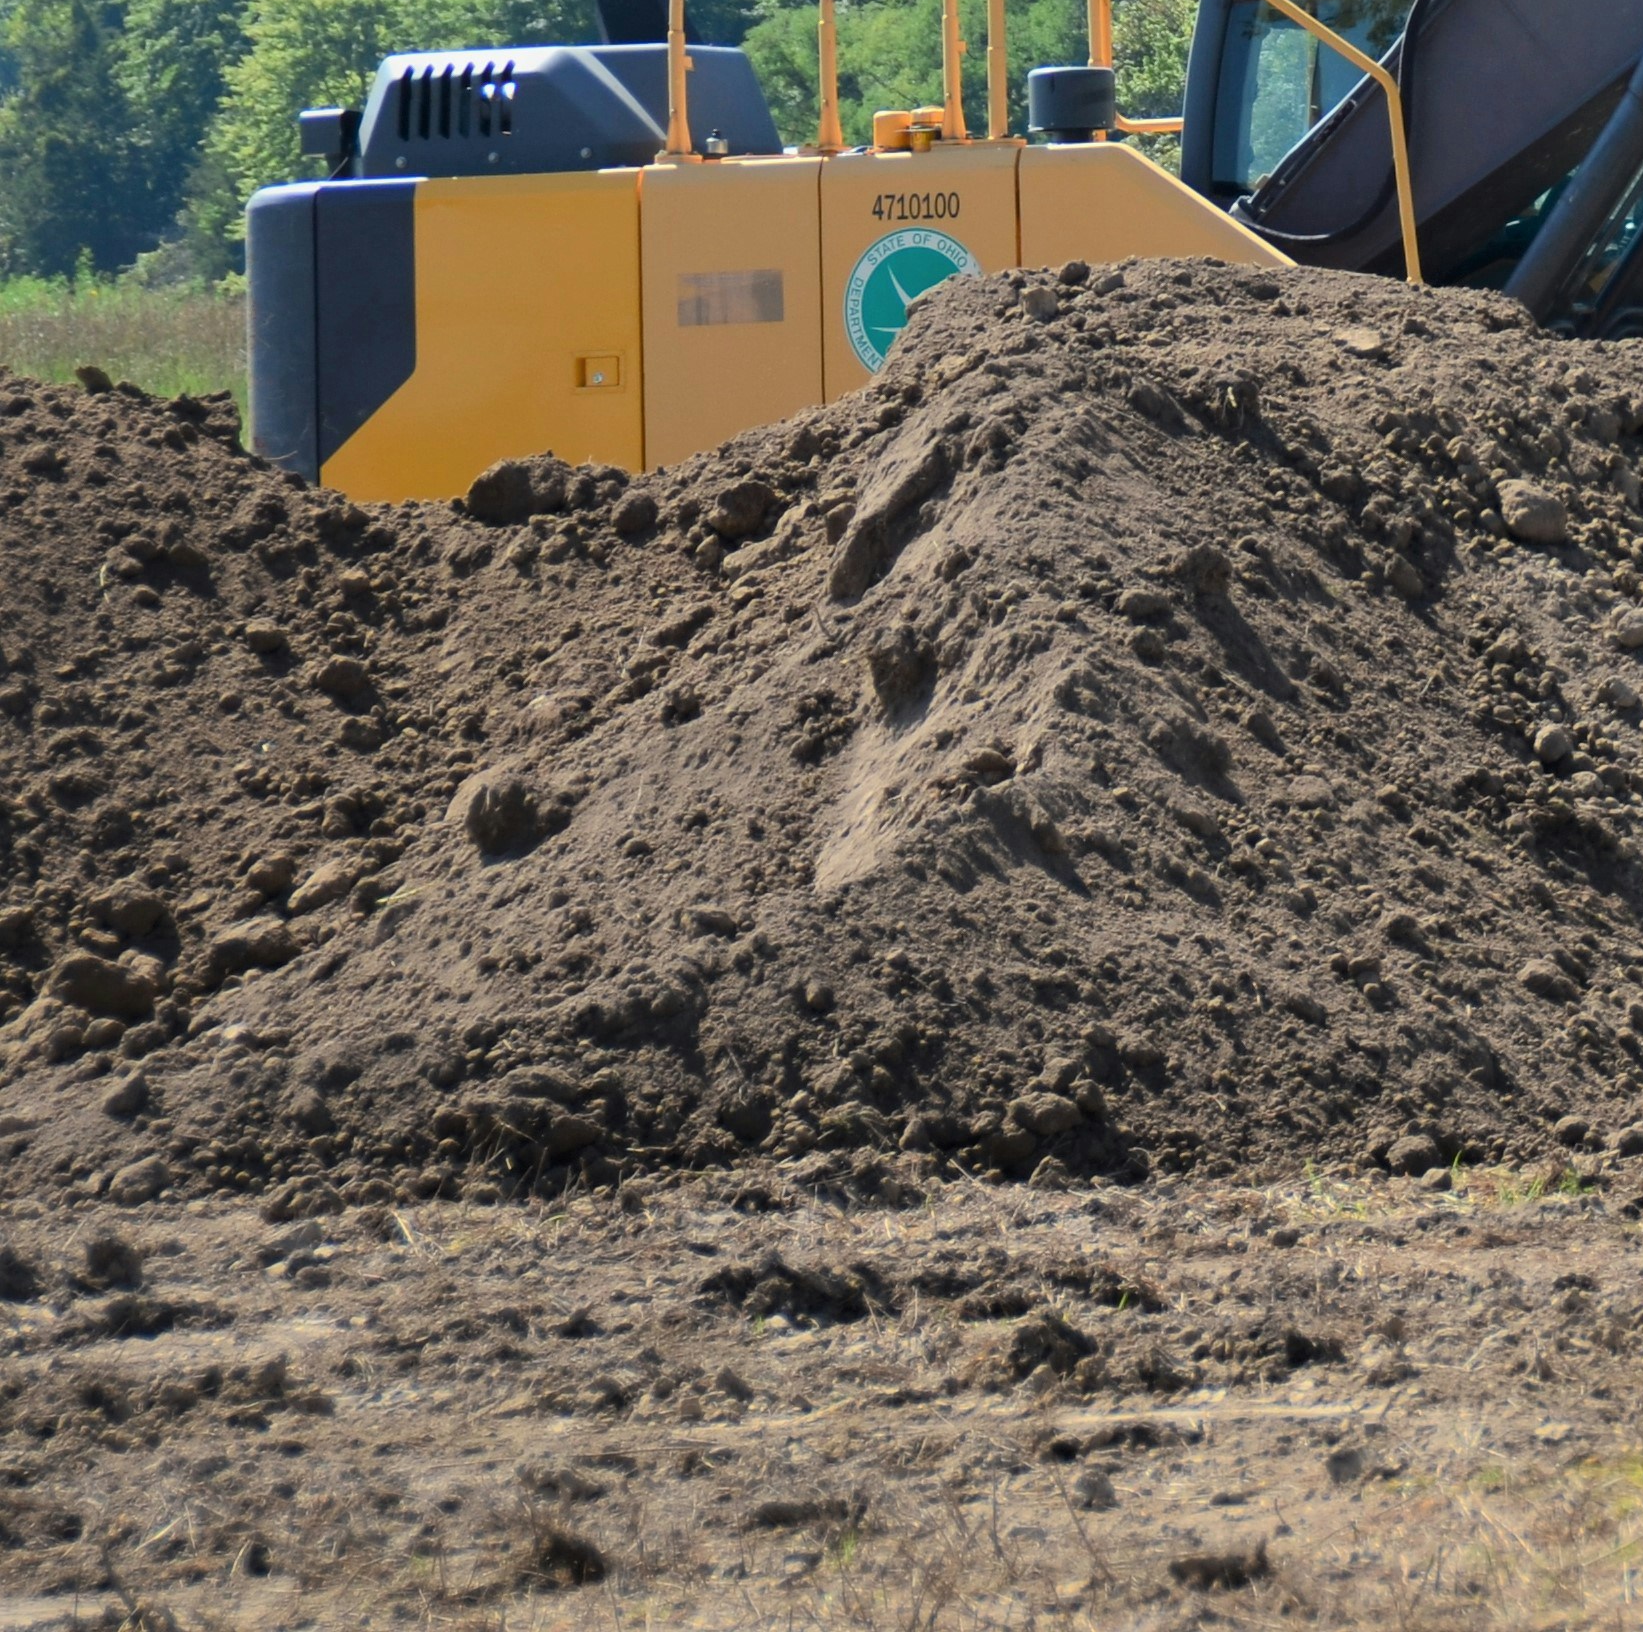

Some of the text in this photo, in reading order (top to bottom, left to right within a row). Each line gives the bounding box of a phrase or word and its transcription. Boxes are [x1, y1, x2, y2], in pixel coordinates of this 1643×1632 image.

[872, 192, 960, 220] 4710100
[867, 233, 968, 268] STATE OF OHIO
